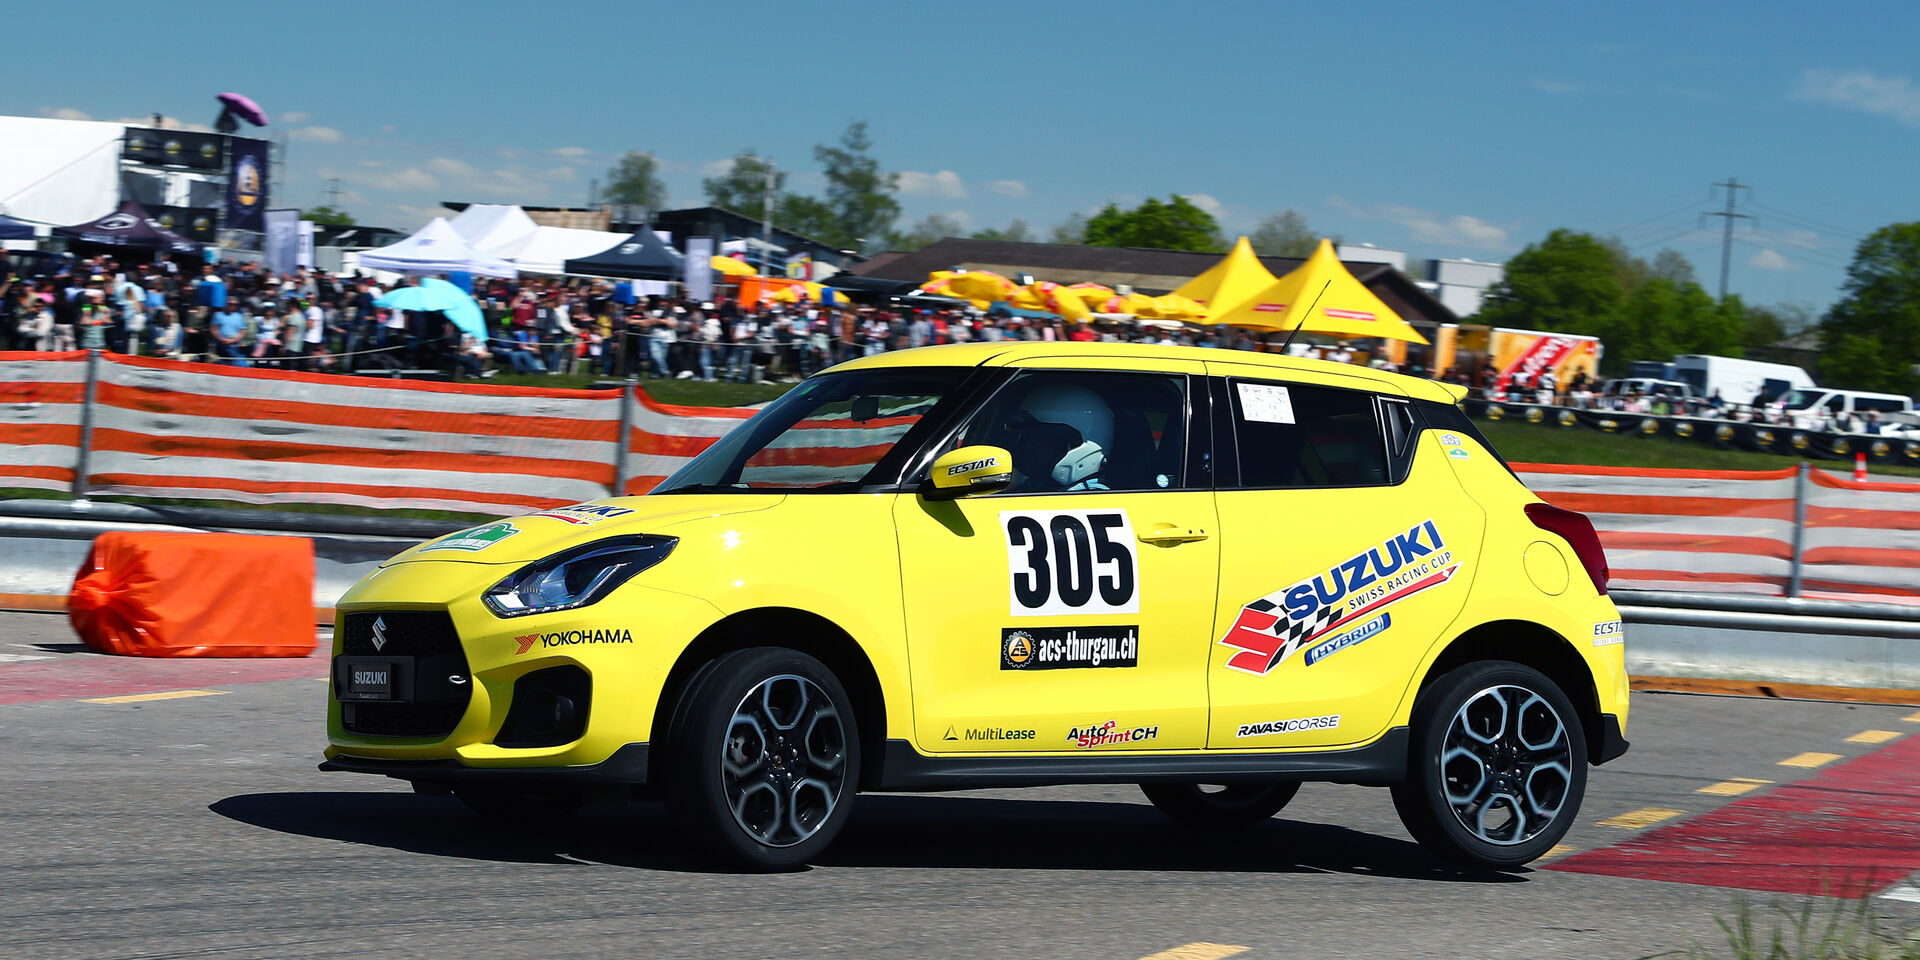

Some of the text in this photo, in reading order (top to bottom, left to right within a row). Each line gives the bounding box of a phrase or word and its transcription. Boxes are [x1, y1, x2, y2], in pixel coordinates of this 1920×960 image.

[948, 457, 995, 476] ECSTAR
[1007, 514, 1134, 609] 305
[1284, 520, 1443, 620] SUZUKI
[1349, 551, 1452, 610] SWISS RACING CUP
[540, 629, 633, 648] YOKOHAMA
[1039, 629, 1136, 666] acs-thurgau.ch
[1317, 620, 1380, 659] HYBRID
[354, 671, 387, 685] SUZUKI
[965, 727, 1036, 740] MultiLease
